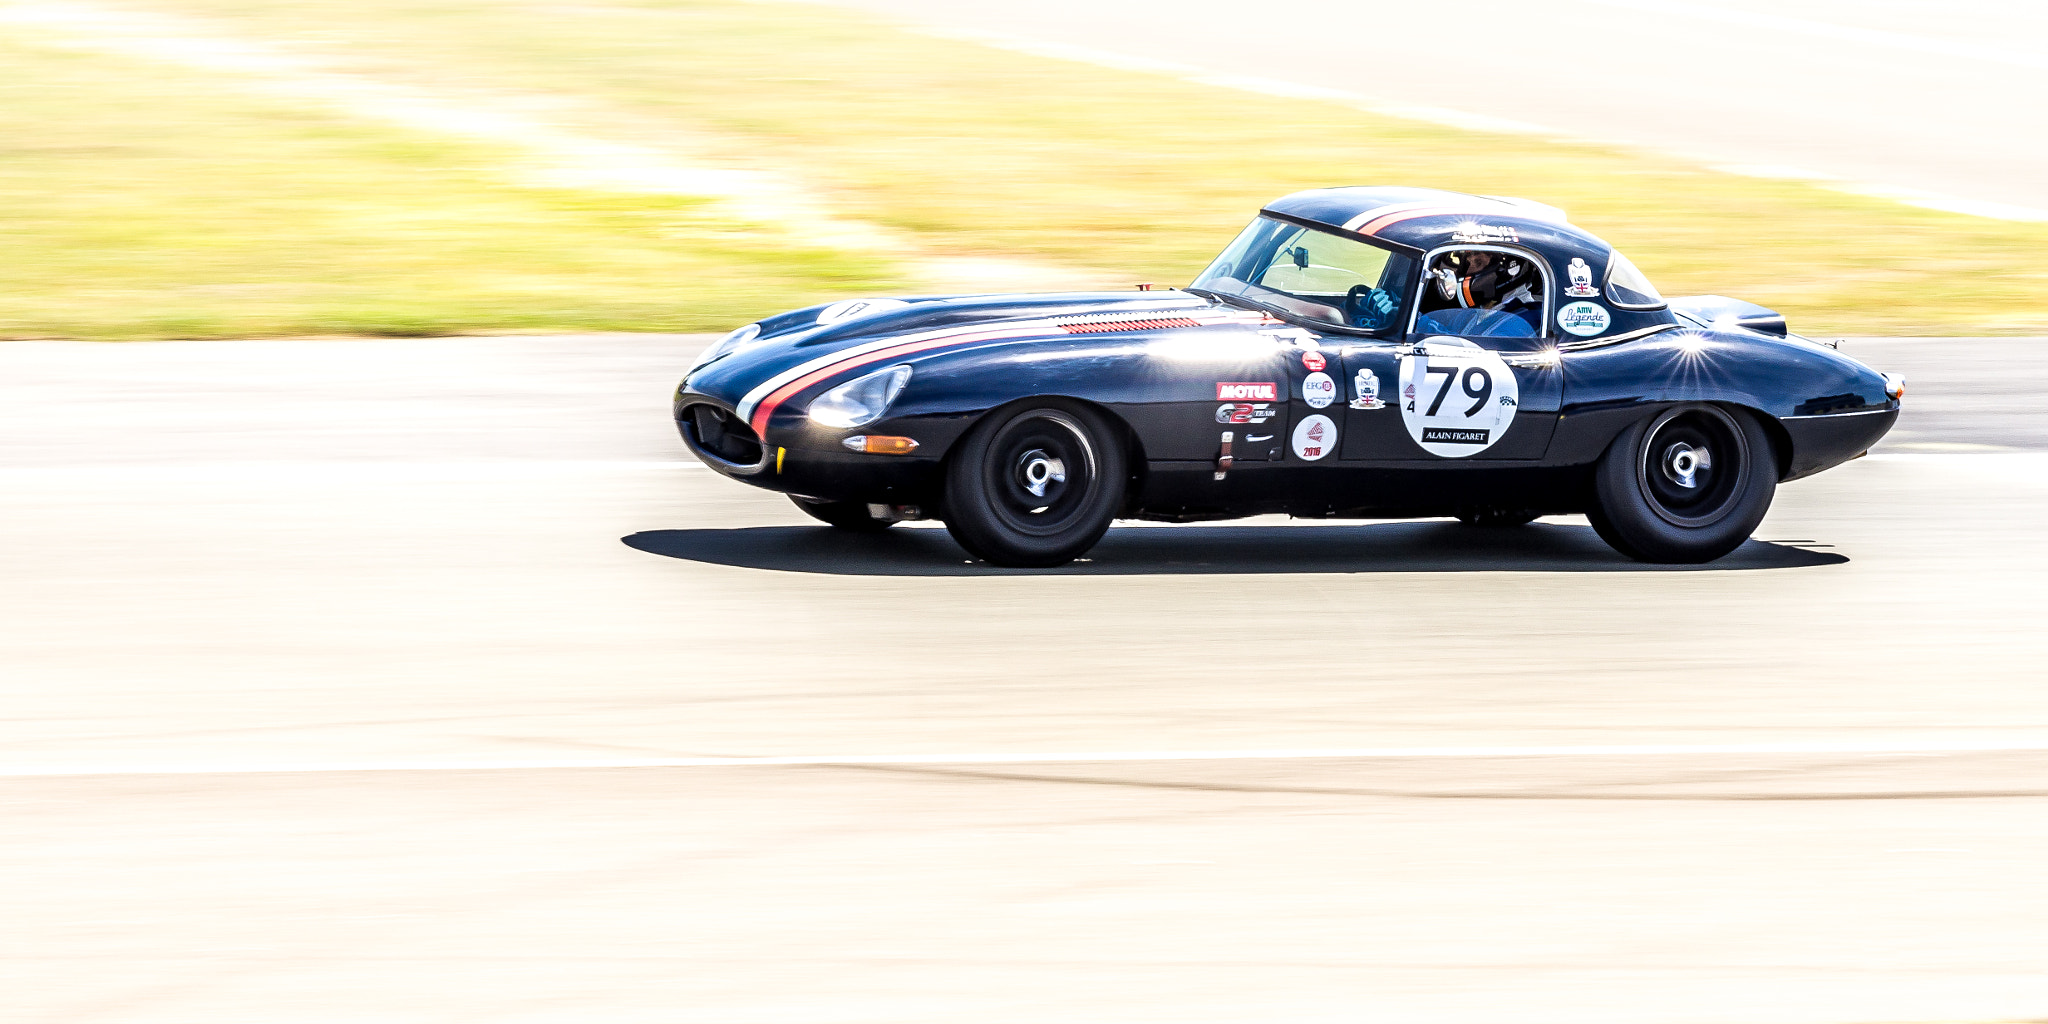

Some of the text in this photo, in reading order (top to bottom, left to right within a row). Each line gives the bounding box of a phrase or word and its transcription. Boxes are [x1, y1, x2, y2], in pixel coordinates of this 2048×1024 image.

[1564, 308, 1605, 325] Légende
[1219, 385, 1275, 399] MOTUL
[1306, 381, 1322, 390] EFG
[1425, 366, 1493, 418] 79
[1406, 400, 1415, 413] 4
[1426, 431, 1486, 441] ALAIN FIGARET
